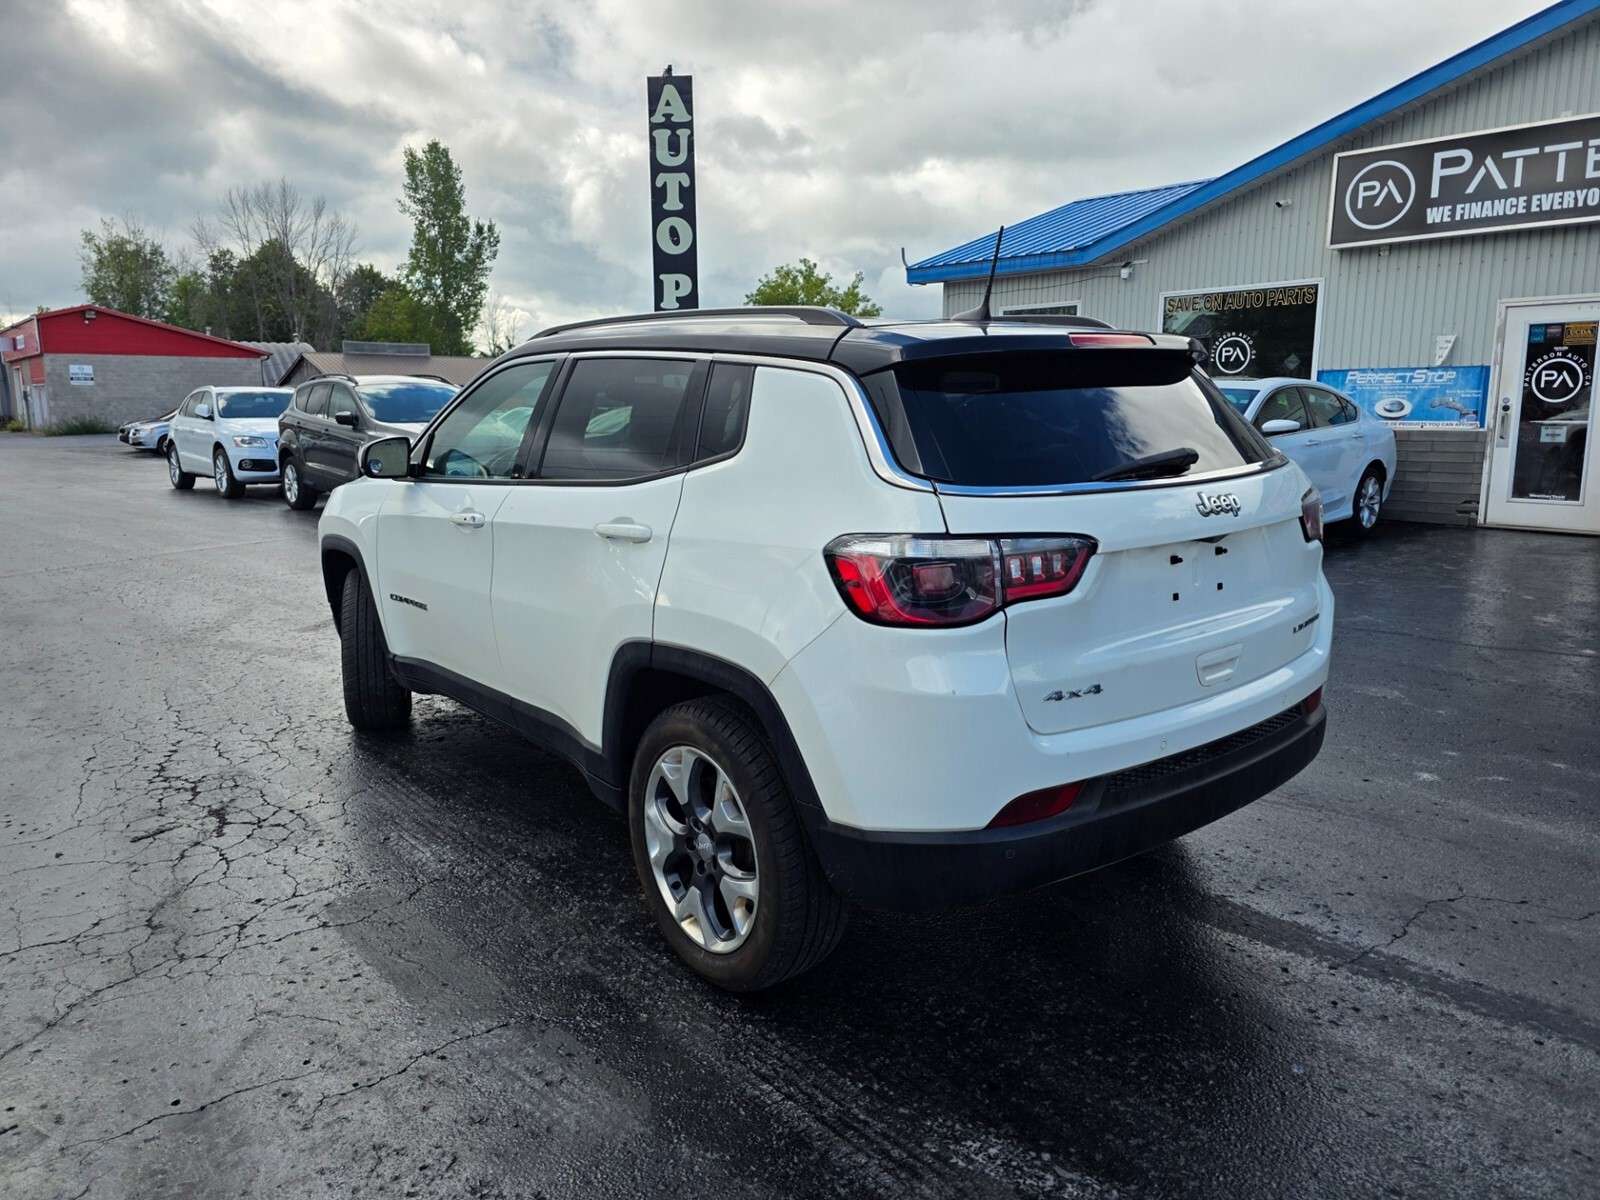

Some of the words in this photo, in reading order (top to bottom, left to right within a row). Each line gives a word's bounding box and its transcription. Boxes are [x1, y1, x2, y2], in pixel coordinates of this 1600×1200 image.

[650, 84, 693, 255] AUTO
[1357, 179, 1404, 210] PA
[1426, 206, 1452, 224] WE
[1455, 196, 1528, 221] FINANCE
[1530, 187, 1600, 213] EVERYO
[1166, 296, 1201, 313] SAVE
[1203, 293, 1223, 311] ON
[1223, 290, 1265, 310] AUTO
[1266, 286, 1317, 307] PARTS
[1221, 346, 1245, 362] PA
[1524, 352, 1563, 387] PATTERSON
[1567, 353, 1589, 369] AUTO
[1540, 370, 1575, 389] PA
[1195, 491, 1241, 517] Jeep
